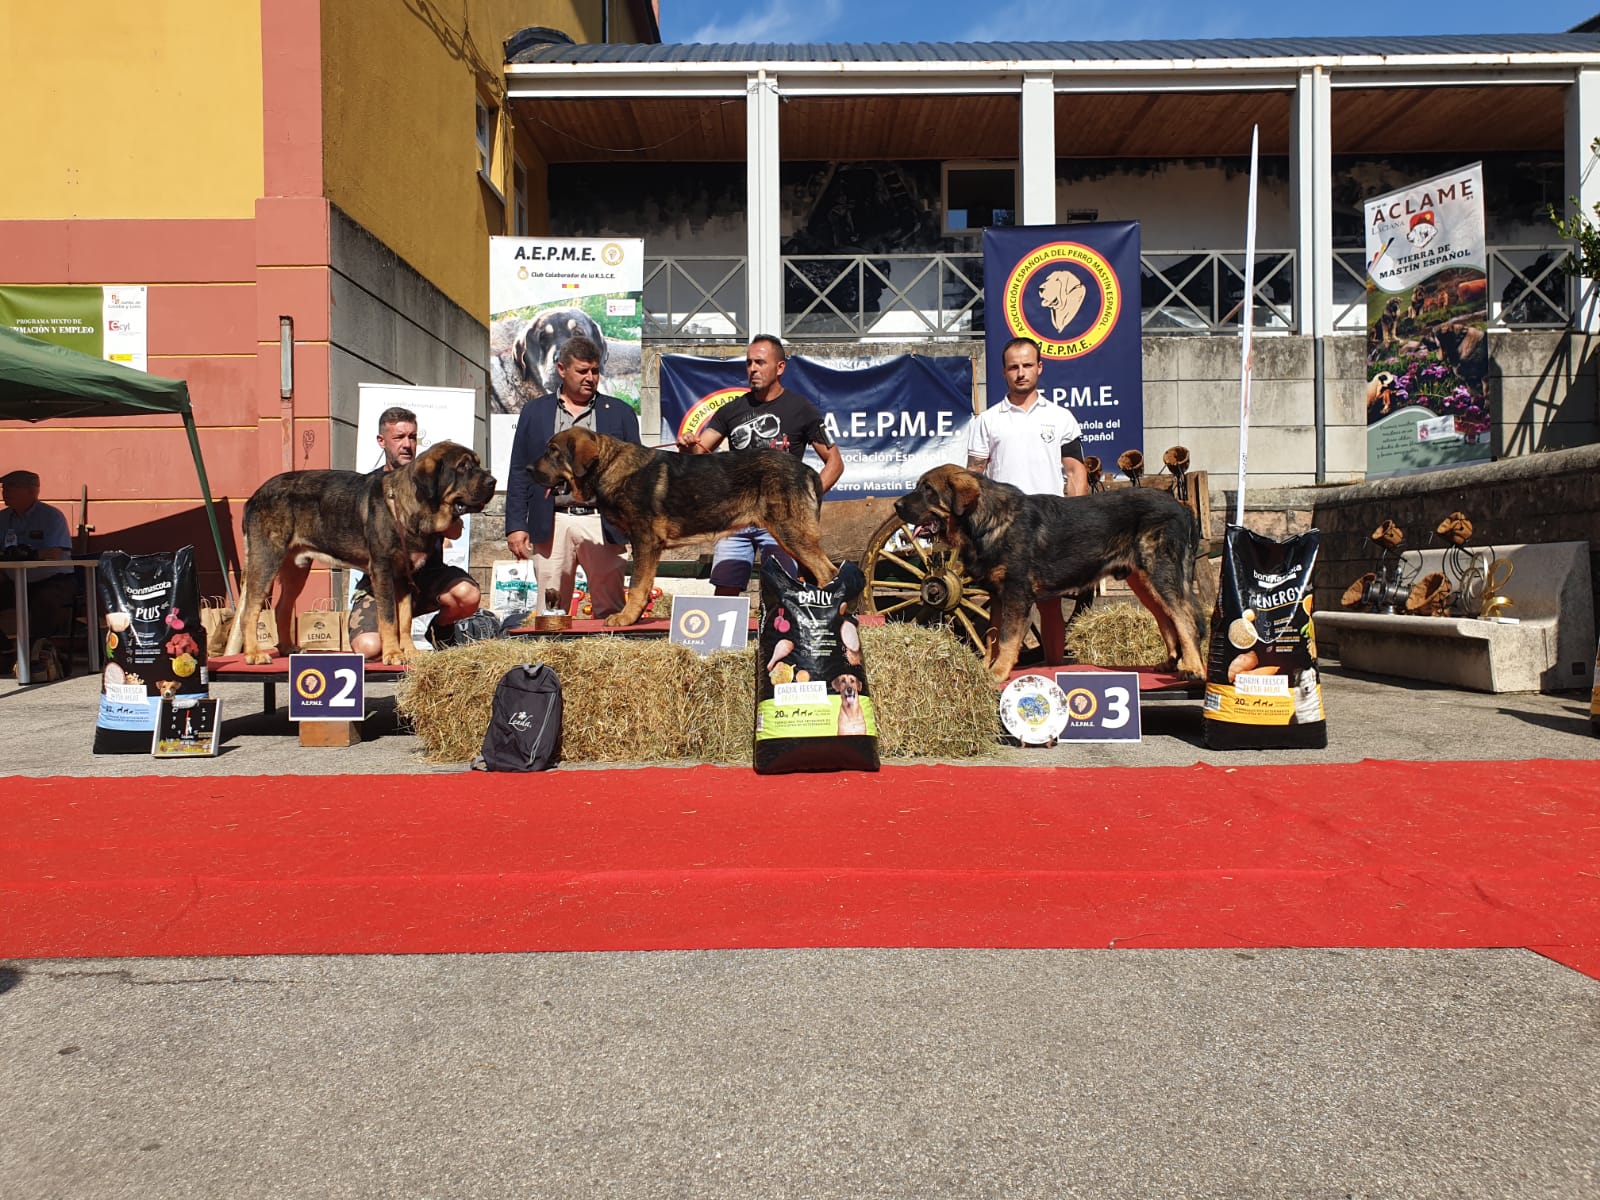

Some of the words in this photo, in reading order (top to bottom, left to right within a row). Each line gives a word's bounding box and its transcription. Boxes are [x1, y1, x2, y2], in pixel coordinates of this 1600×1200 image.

[1373, 179, 1473, 226] ACLAME
[514, 246, 596, 261] A.E.P.M.E.
[1050, 249, 1066, 257] DEL
[1068, 249, 1093, 264] PERRO
[1398, 249, 1435, 265] TIERRA
[1438, 244, 1451, 255] DE
[1016, 252, 1050, 283] ESPAÑOLA
[1380, 262, 1420, 280] MASTÍN
[1423, 249, 1471, 268] ESPAÑOL
[1092, 262, 1112, 292] MASTÍN
[1010, 282, 1025, 332] ASOCIACIÓN
[1100, 292, 1114, 326] ESPAÑOL
[824, 411, 961, 438] A.E.P.M.E.
[1078, 420, 1104, 430] añola
[1106, 419, 1120, 428] del
[842, 452, 892, 462] sociación
[864, 480, 902, 491] Mastín
[126, 581, 172, 594] bonmascota
[798, 590, 832, 606] DAILY
[1256, 586, 1302, 608] ENERGY
[136, 606, 160, 620] PLUS
[257, 632, 272, 640] NDA
[718, 610, 738, 647] 1
[329, 668, 358, 707] 2
[1102, 686, 1130, 728] 3
